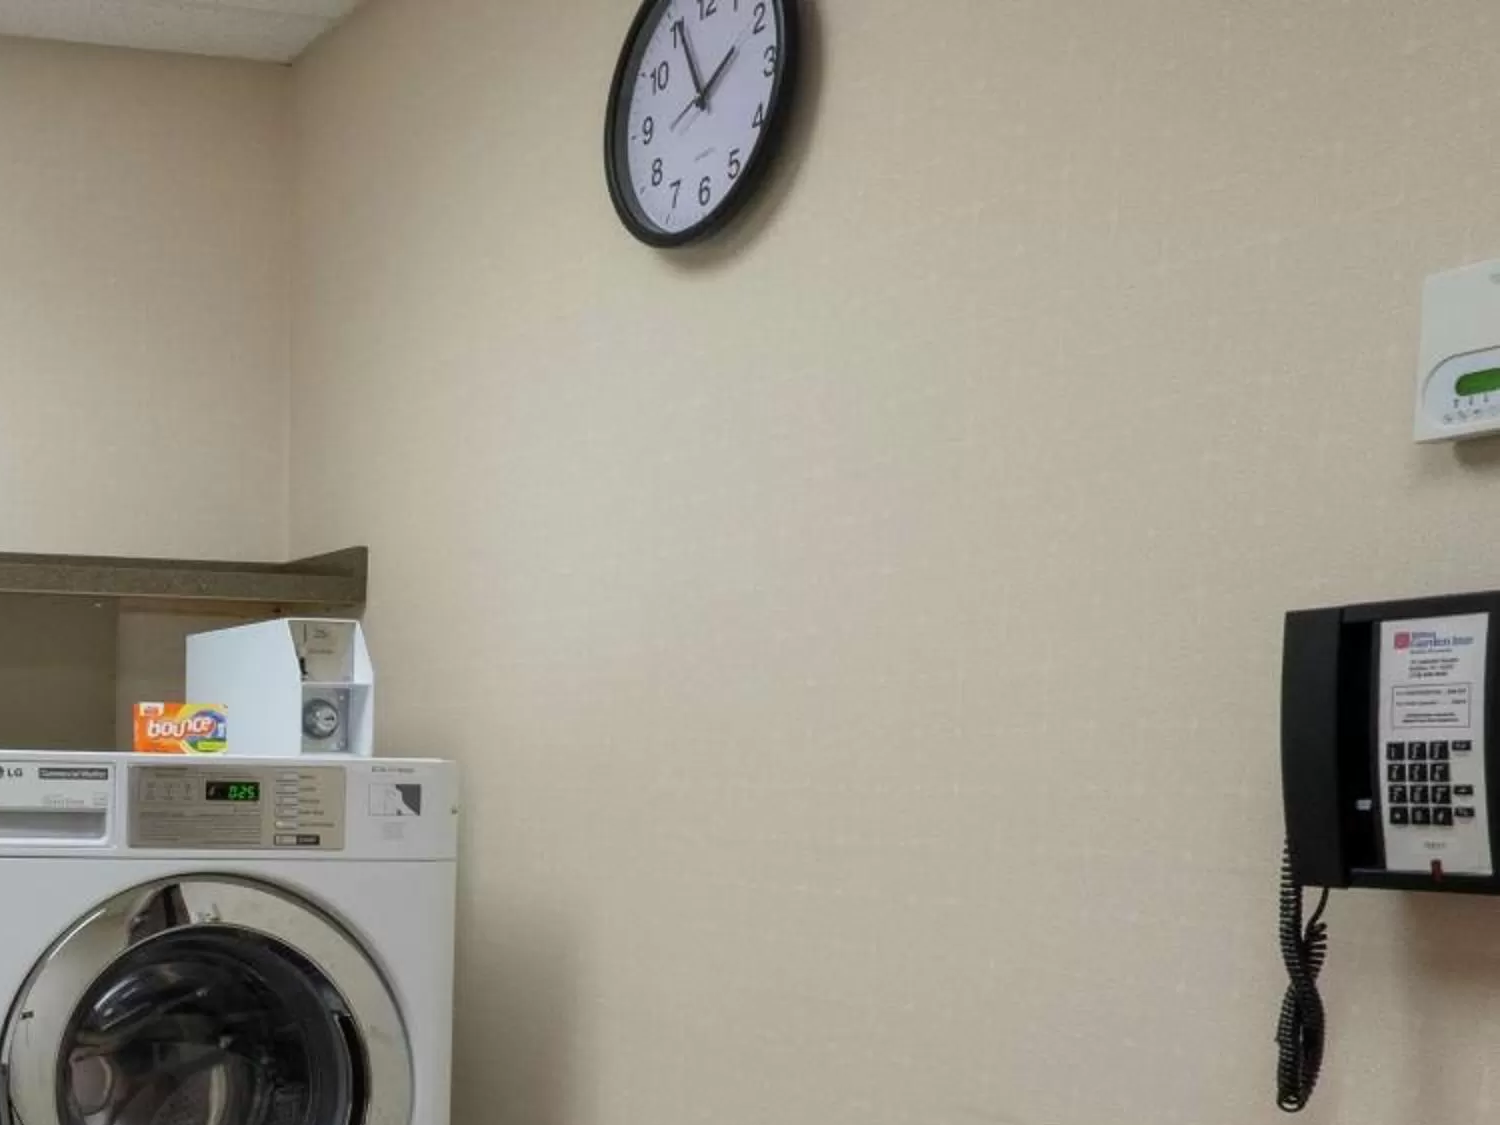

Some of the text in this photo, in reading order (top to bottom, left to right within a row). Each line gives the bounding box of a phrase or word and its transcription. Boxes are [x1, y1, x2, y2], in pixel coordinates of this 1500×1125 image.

[752, 2, 766, 35] 2
[763, 45, 776, 78] 3
[650, 60, 669, 95] 10
[642, 115, 654, 145] 9
[752, 102, 764, 129] 4
[651, 157, 663, 187] 8
[727, 147, 741, 180] 5
[669, 179, 681, 208] 7
[699, 175, 711, 206] 6
[147, 717, 213, 738] bounce
[7, 767, 23, 777] LG
